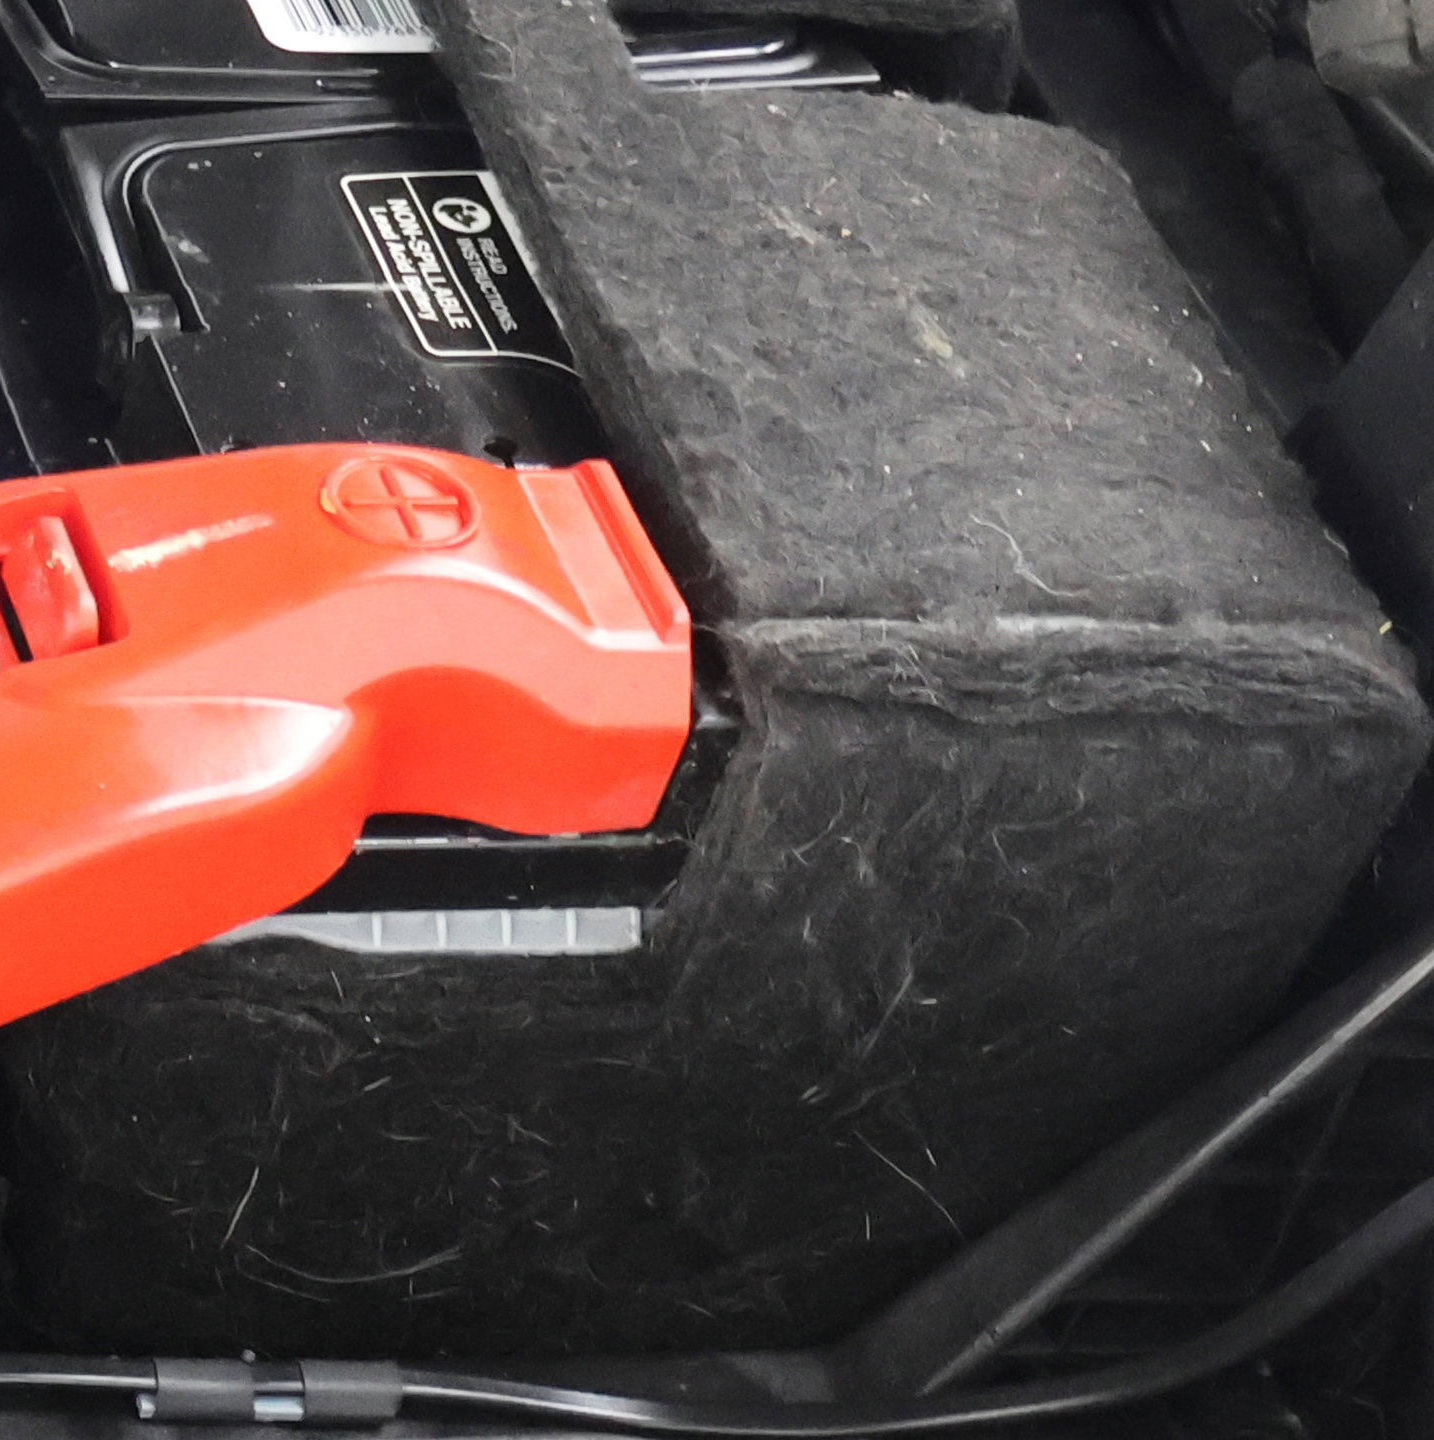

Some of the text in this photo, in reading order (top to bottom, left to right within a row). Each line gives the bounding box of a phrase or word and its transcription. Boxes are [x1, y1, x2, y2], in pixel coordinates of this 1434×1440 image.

[368, 208, 439, 321] Lead Acid Battery
[386, 199, 473, 328] NON-SPILLABLE
[477, 239, 509, 273] READ
